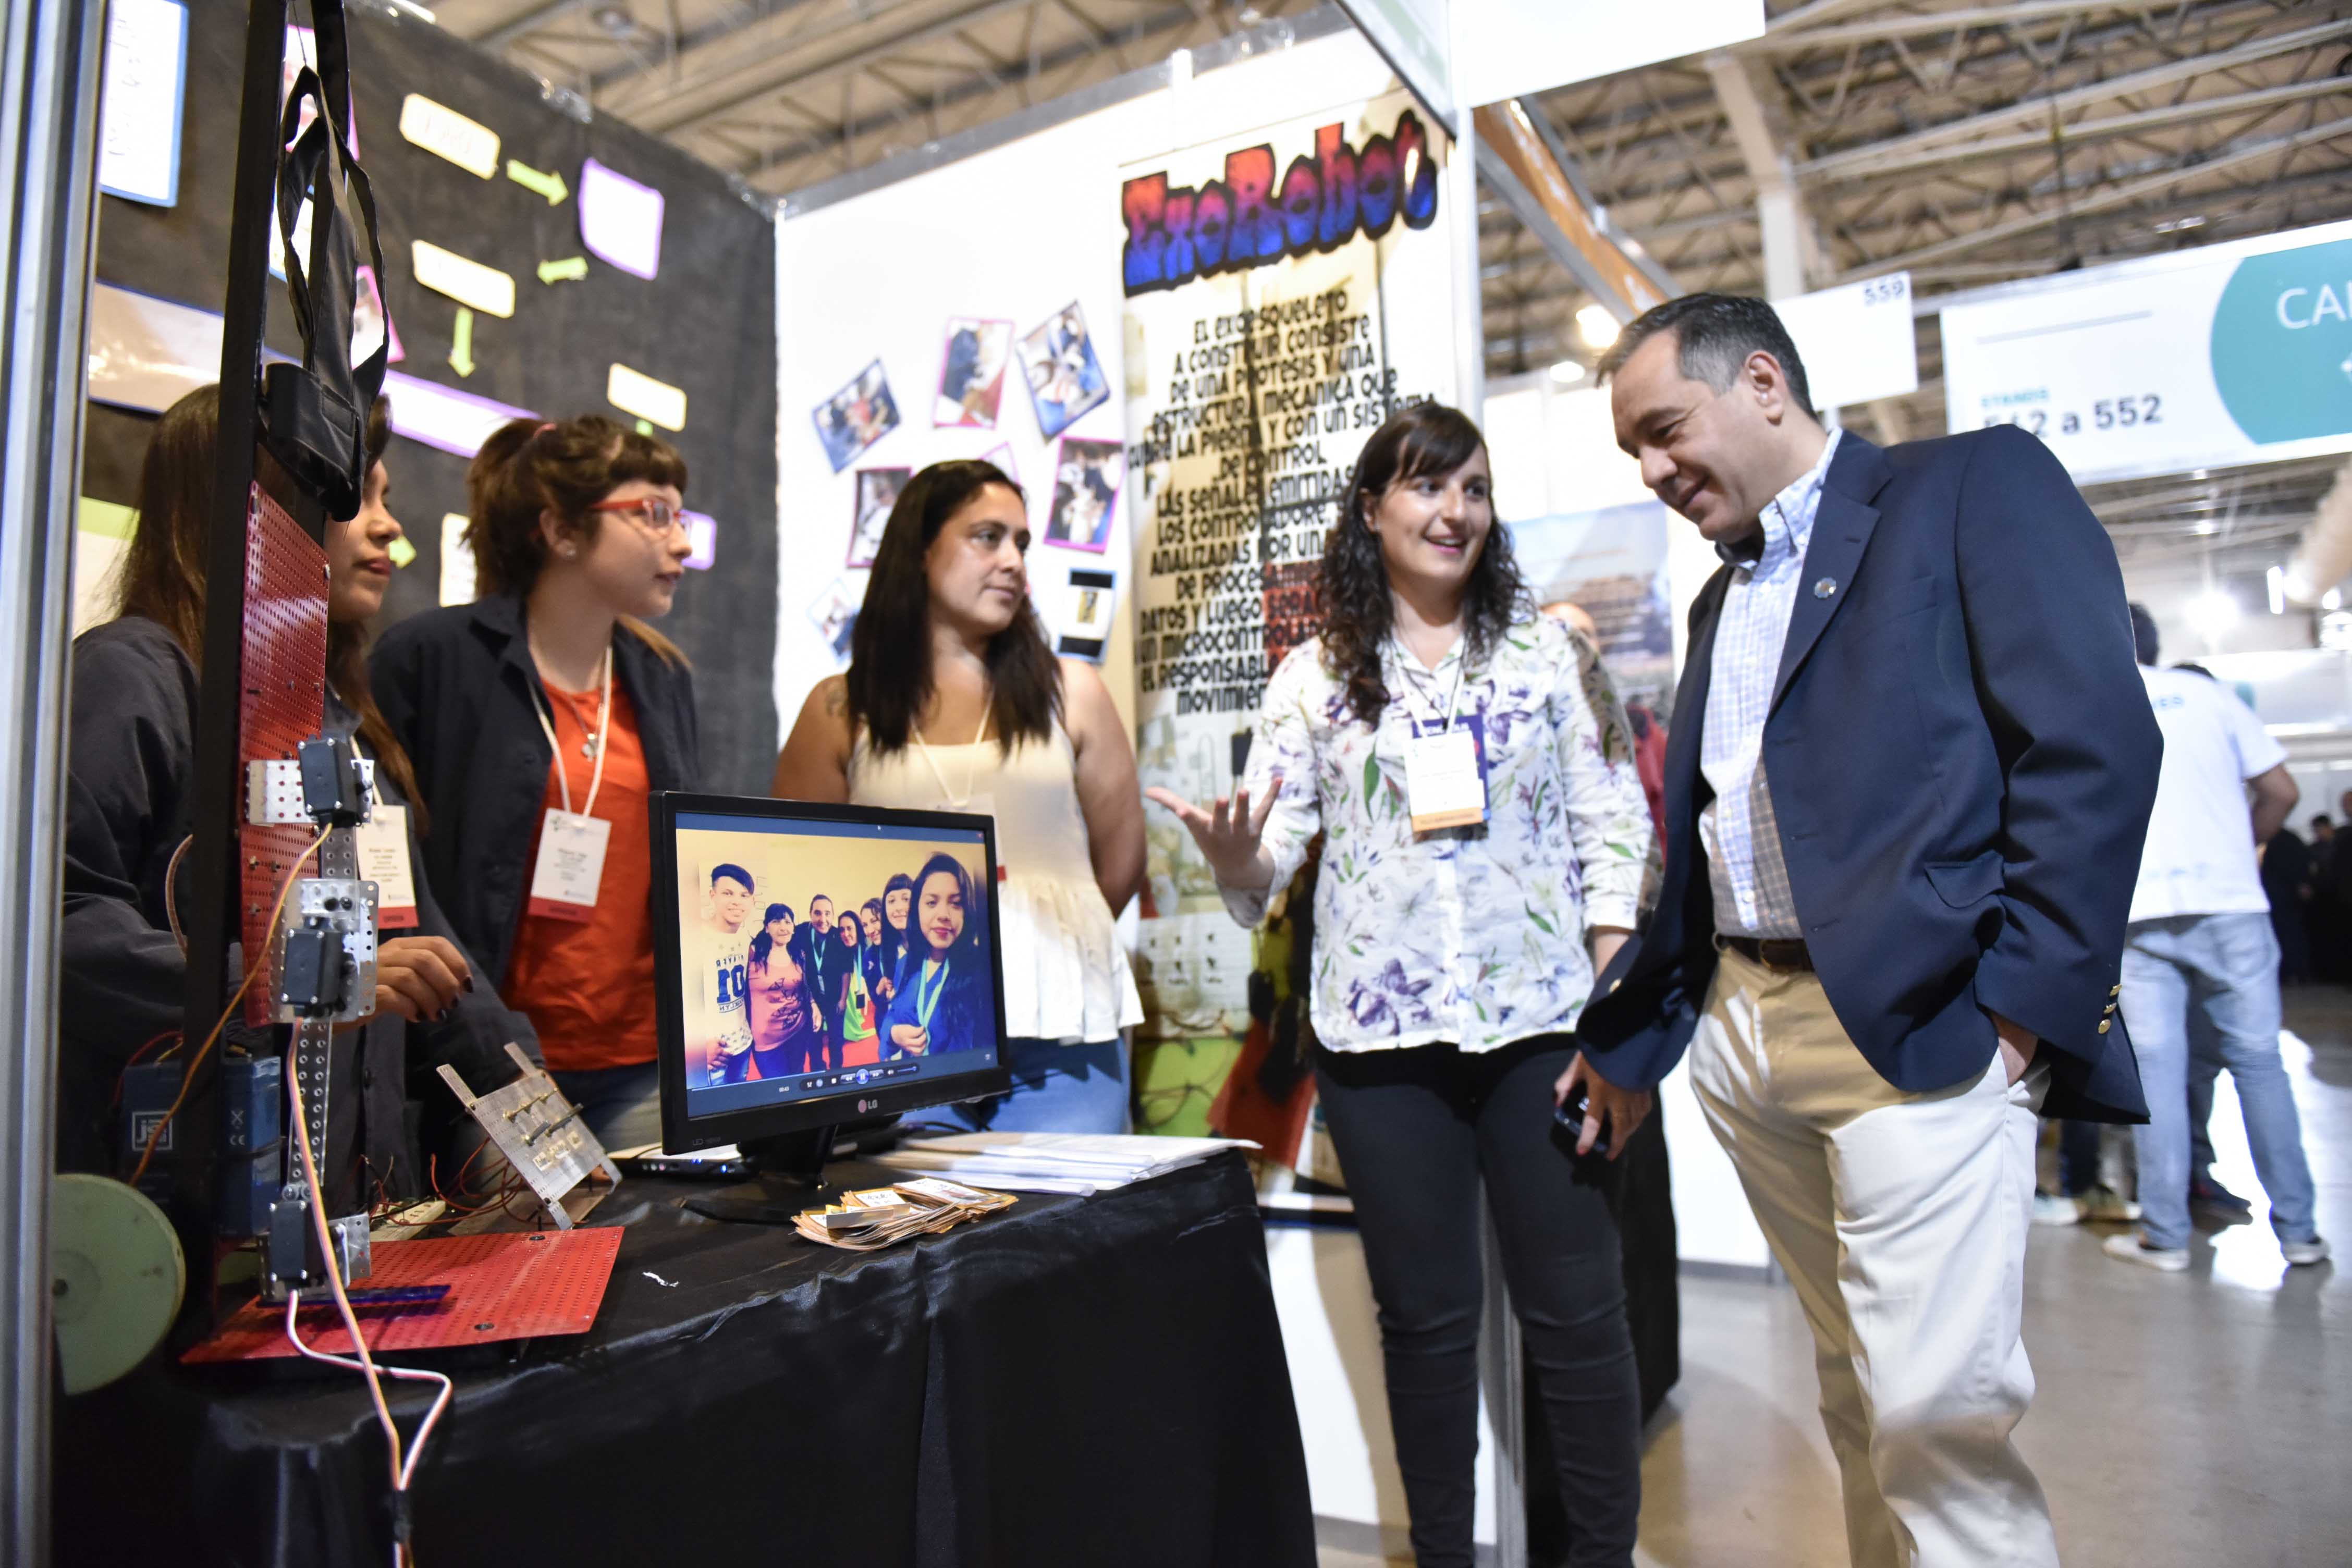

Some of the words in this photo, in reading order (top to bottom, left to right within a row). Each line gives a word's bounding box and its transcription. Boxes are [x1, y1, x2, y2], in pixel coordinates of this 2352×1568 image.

[2062, 412, 2080, 434] a
[2094, 394, 2162, 430] 552
[867, 1099, 878, 1109] LG
